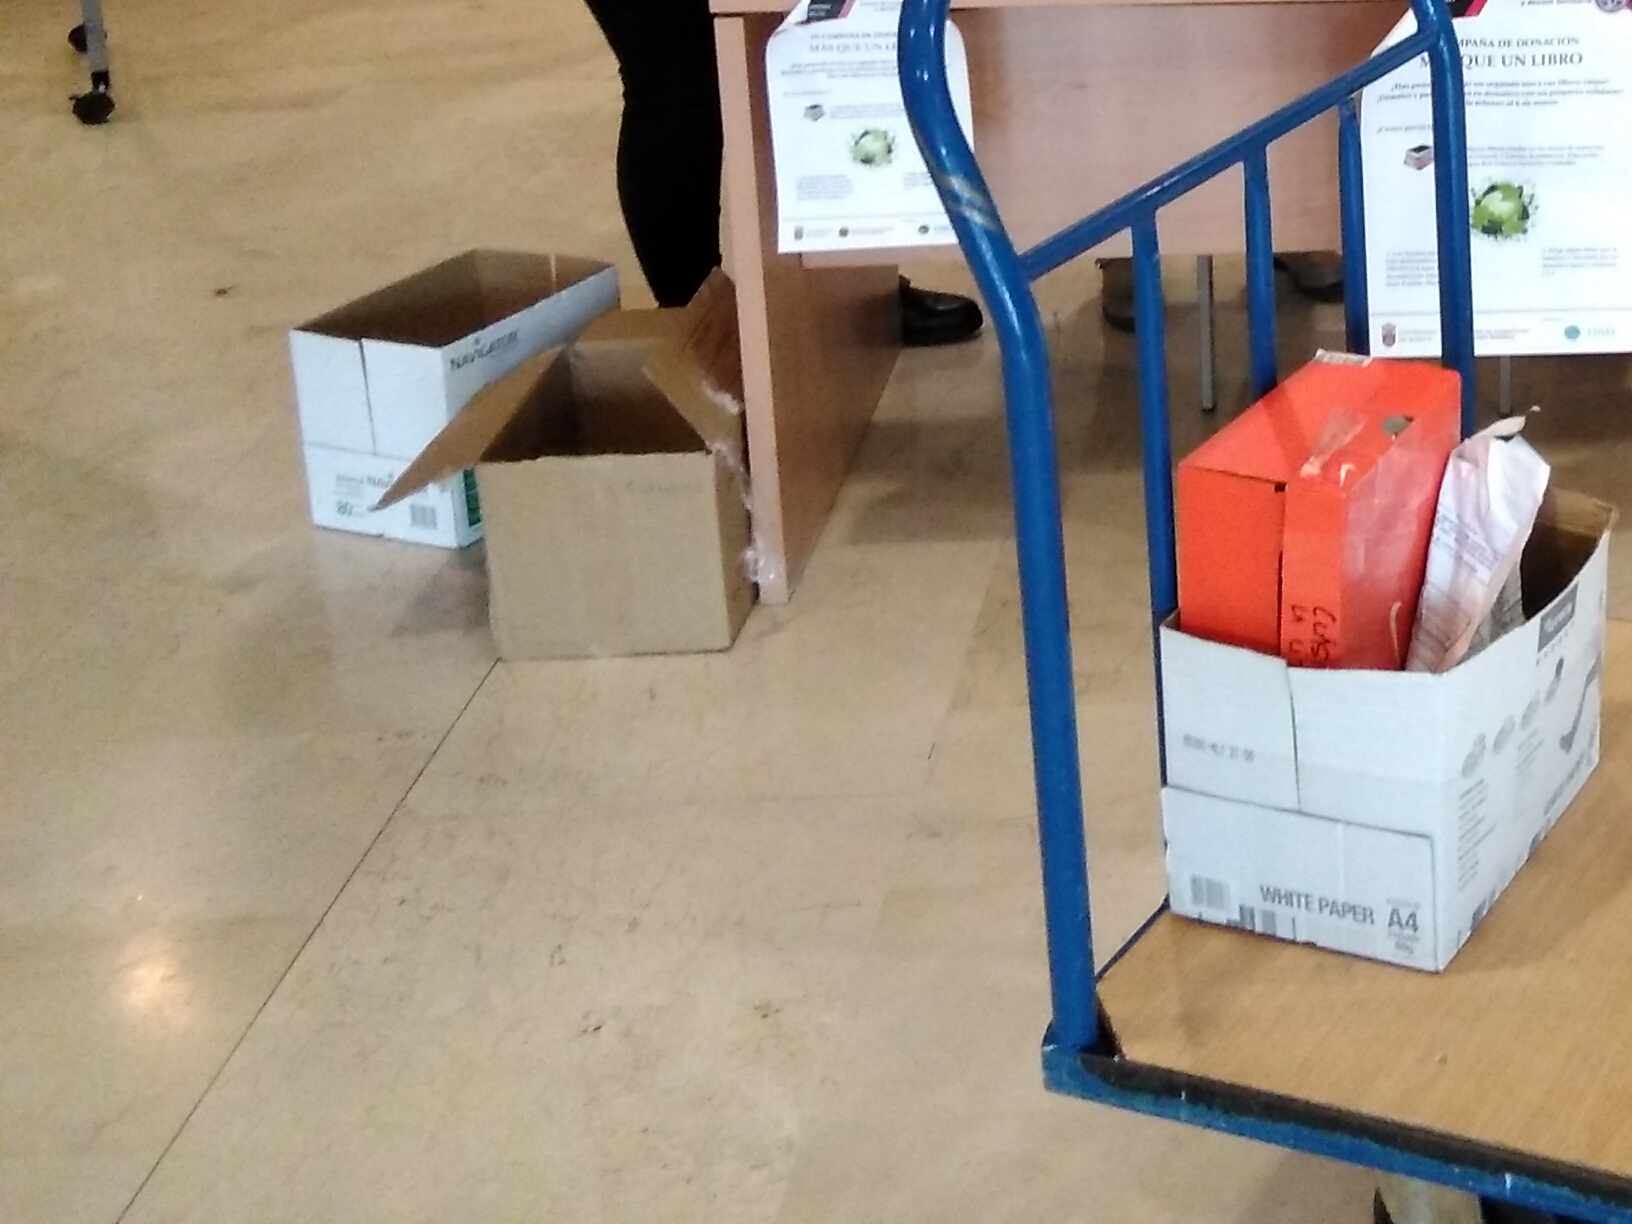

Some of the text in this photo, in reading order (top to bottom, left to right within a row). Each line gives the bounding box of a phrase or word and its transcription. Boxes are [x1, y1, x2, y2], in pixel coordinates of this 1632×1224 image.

[1501, 52, 1526, 68] UN
[1531, 51, 1583, 67] LIBRO
[1259, 884, 1376, 925] WHITE PAPER
[1388, 907, 1420, 933] A4
